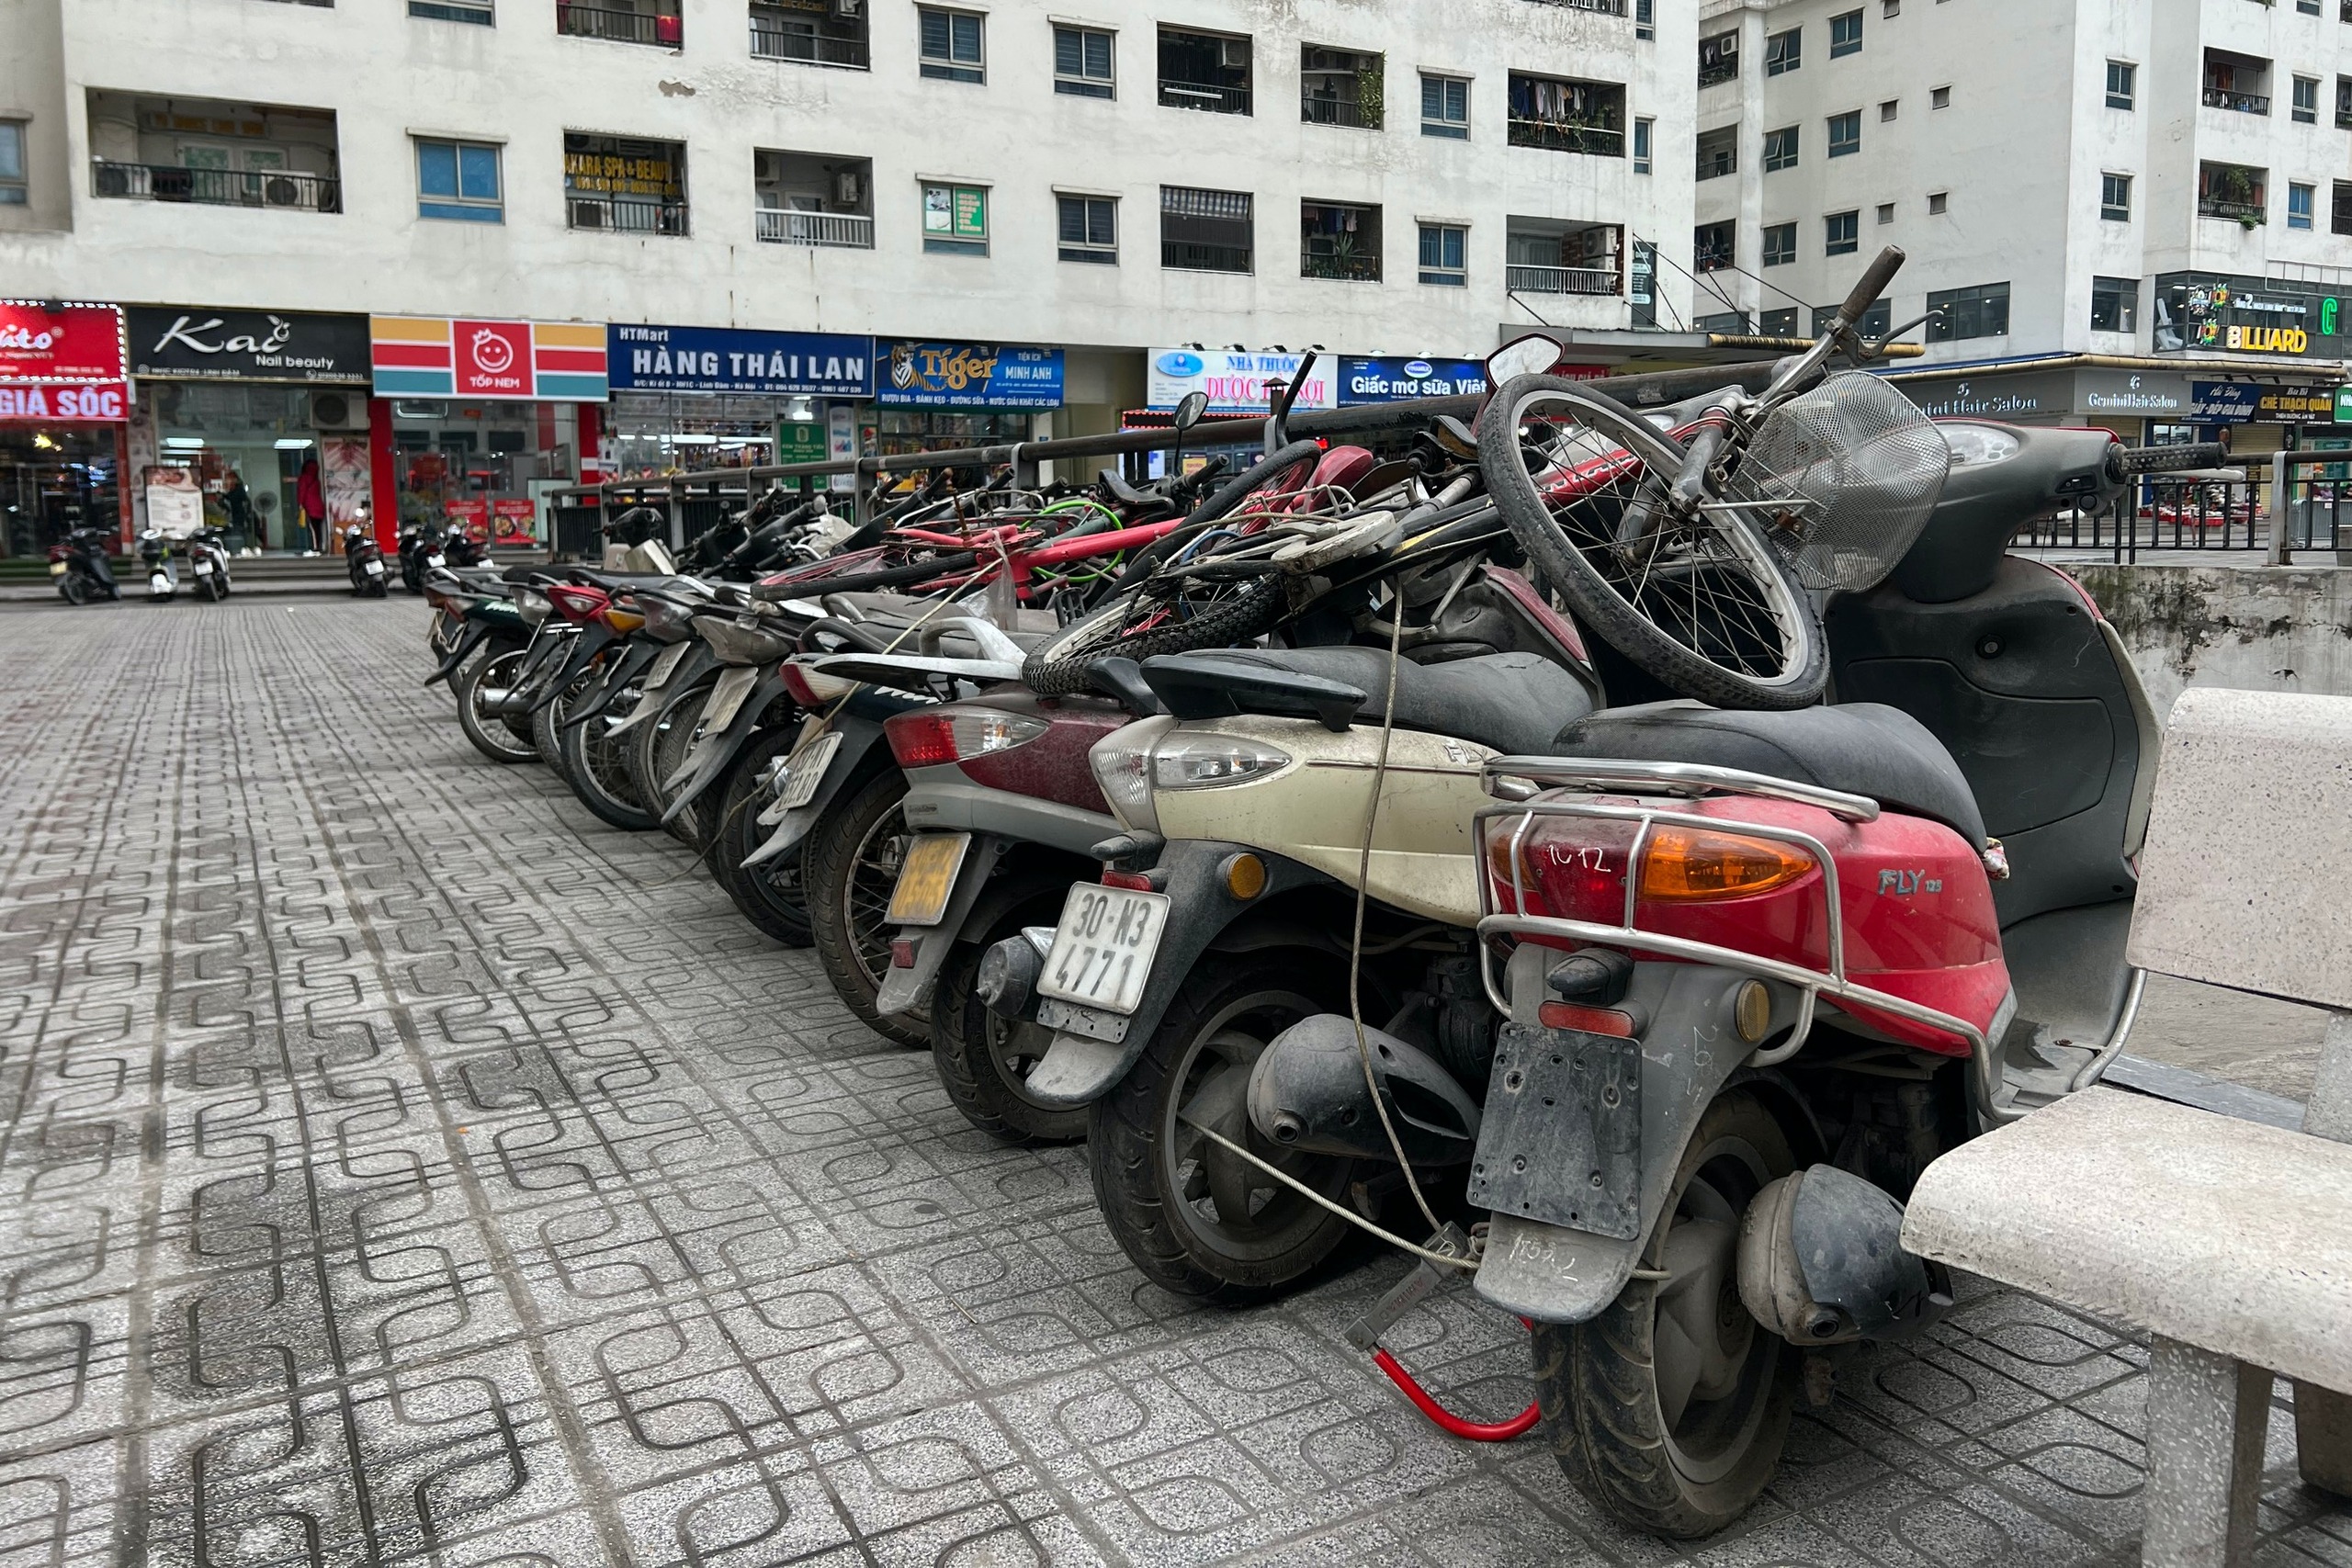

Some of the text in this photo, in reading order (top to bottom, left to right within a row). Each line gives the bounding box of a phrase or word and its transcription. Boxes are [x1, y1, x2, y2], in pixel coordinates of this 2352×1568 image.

[619, 327, 669, 342] HTMart
[2227, 325, 2307, 353] BILLIARD
[256, 355, 334, 369] Nail beauty
[633, 345, 864, 381] HÀNG THÁI LAN
[920, 347, 998, 389] Tiger
[1005, 366, 1052, 379] MINH ANH
[494, 377, 520, 389] NEM
[1205, 374, 1258, 407] DƯỢC
[1351, 375, 1388, 394] Giấc
[1392, 379, 1418, 394] mơ
[1422, 378, 1451, 395] sữa
[1953, 399, 1989, 414] Hair
[1993, 395, 2037, 412] Salon
[2150, 395, 2177, 408] Salon
[2278, 397, 2307, 412] THẠCH
[1878, 869, 1926, 895] FLY
[1056, 943, 1135, 1001] 4771
